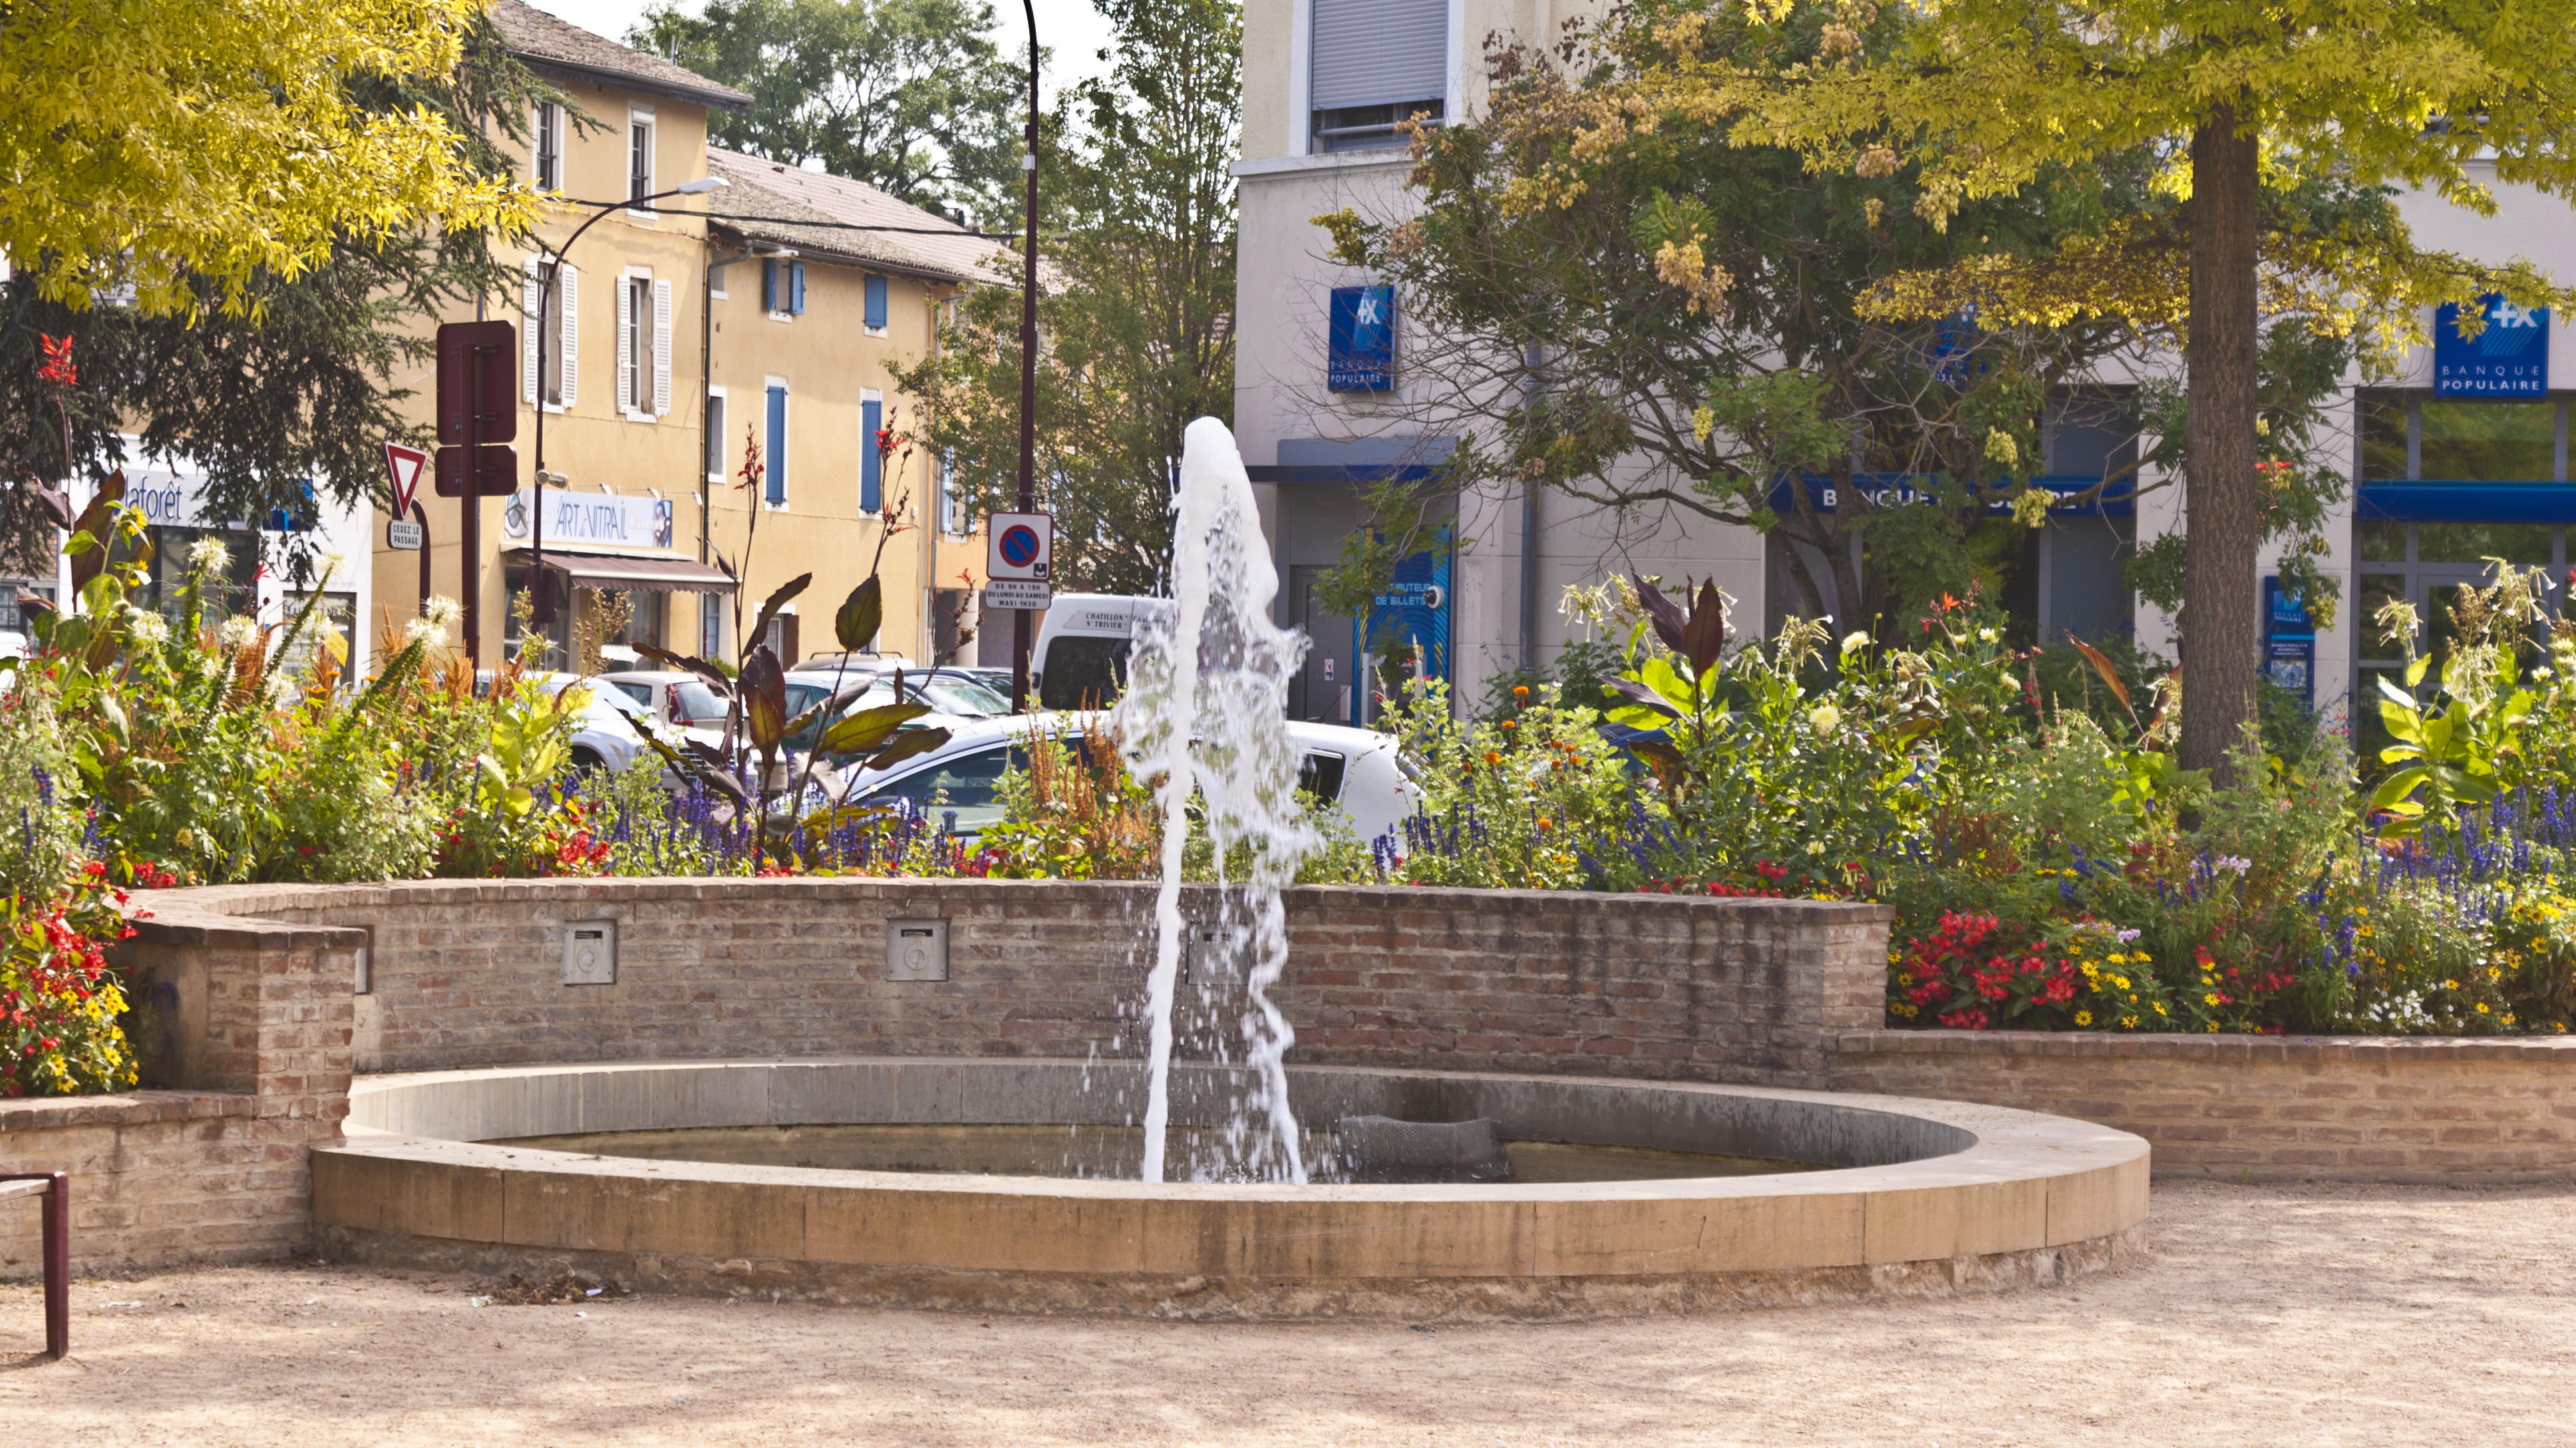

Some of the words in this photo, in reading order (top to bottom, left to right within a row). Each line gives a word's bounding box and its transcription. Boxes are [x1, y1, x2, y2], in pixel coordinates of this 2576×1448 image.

[2443, 366, 2539, 377] BANQUE
[2443, 381, 2539, 391] POPULAIRE
[125, 474, 182, 520] laforêt
[1824, 489, 1929, 508] BNQUE
[413, 526, 420, 535] LE
[394, 535, 418, 546] PASSAGE
[1375, 596, 1387, 605] DE
[1086, 613, 1123, 622] CHATILLON
